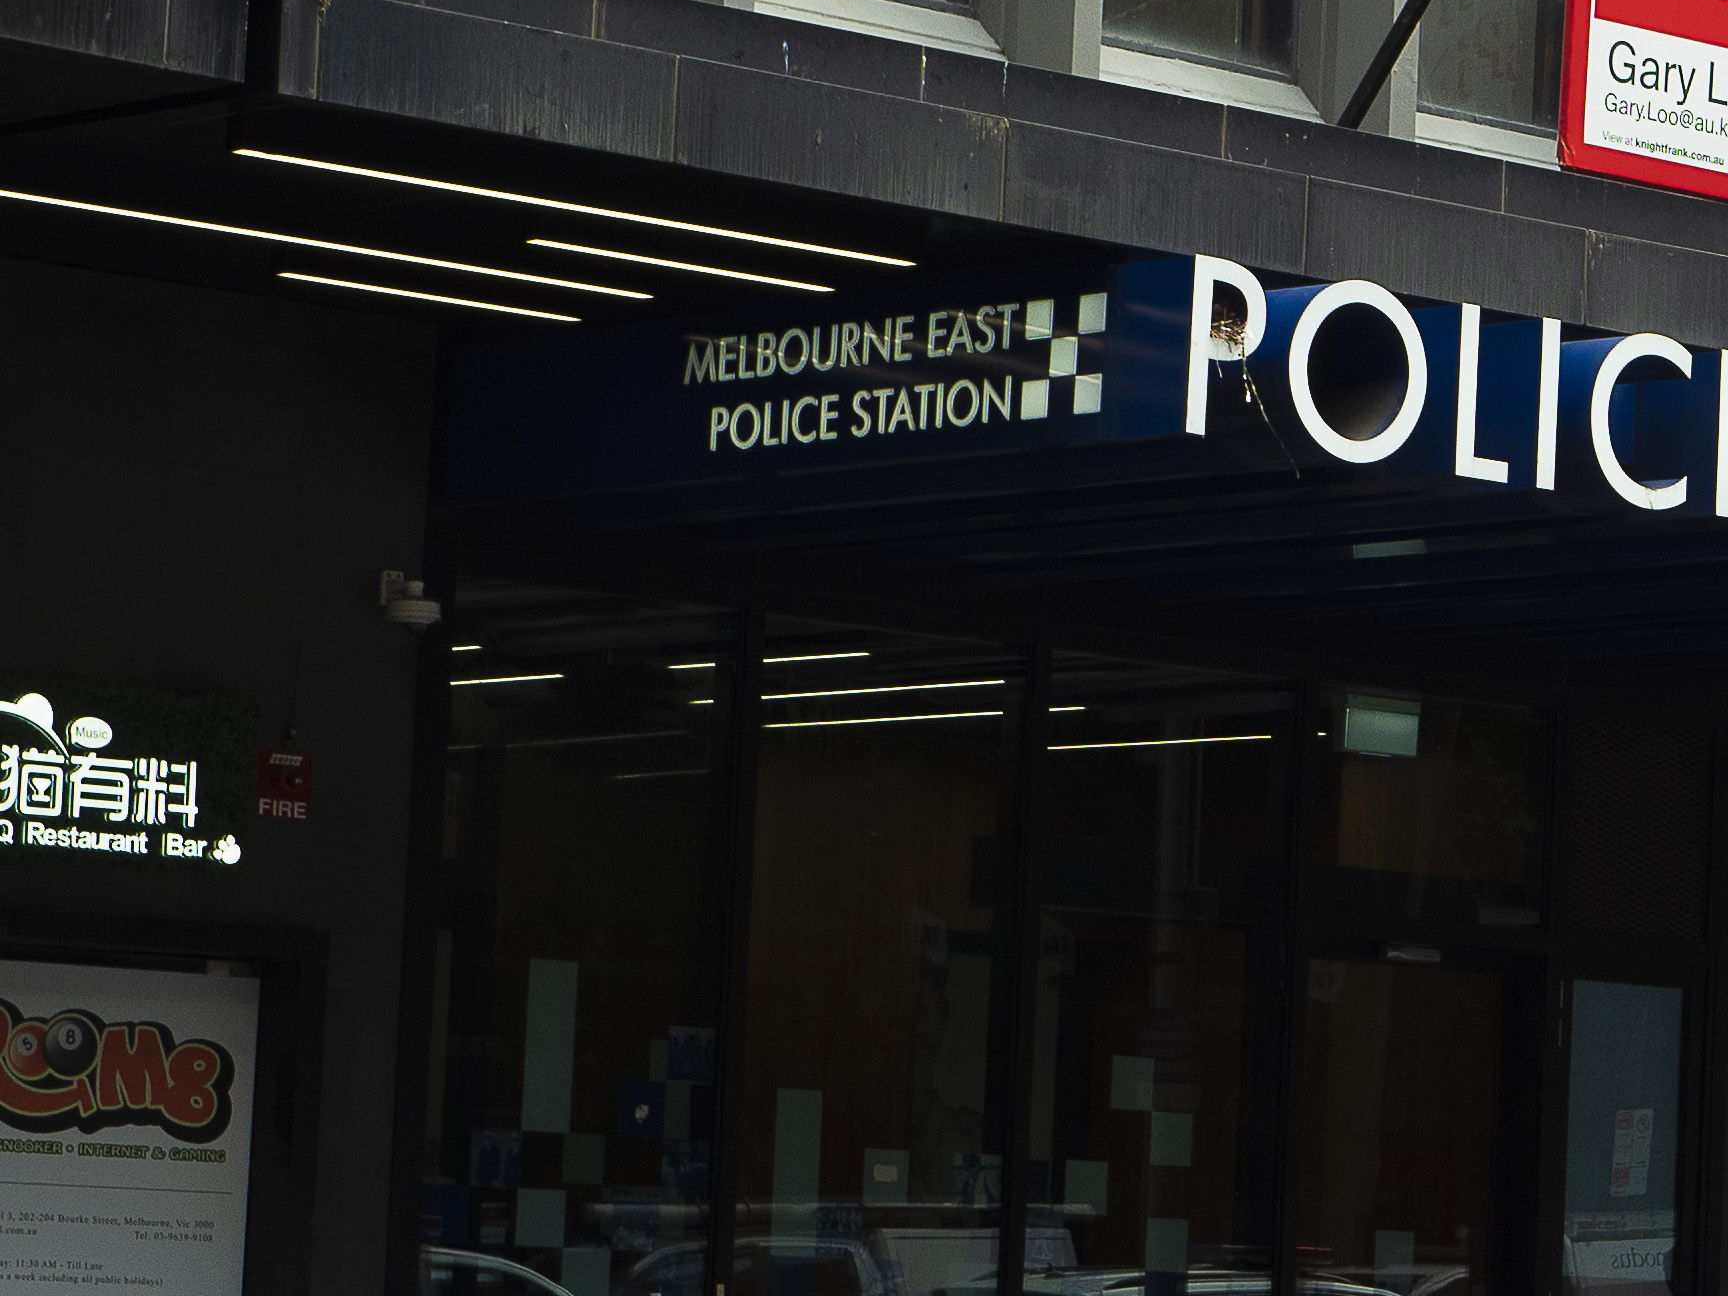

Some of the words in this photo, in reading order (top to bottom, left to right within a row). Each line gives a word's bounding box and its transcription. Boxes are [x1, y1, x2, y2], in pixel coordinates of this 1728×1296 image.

[1607, 39, 1697, 106] Gary
[1601, 129, 1623, 145] View
[1624, 136, 1634, 146] at
[1634, 137, 1725, 166] knightfrank.com.au
[683, 316, 915, 385] MELBOURNE
[927, 304, 1020, 359] EAST
[709, 394, 840, 452] POLICE
[851, 375, 1012, 438] STATION
[75, 726, 109, 740] Music
[259, 798, 307, 820] FIRE
[25, 821, 149, 854] Restaurant
[165, 833, 208, 858] Bar
[65, 1029, 76, 1047] 8
[78, 1142, 149, 1160] INTERNET
[151, 1146, 165, 1160] &
[169, 1148, 228, 1164] GAMING
[18, 1212, 55, 1223] 202-204
[57, 1214, 89, 1225] Bourke
[123, 1217, 173, 1230] Melbourne,
[39, 1274, 79, 1286] including
[95, 1276, 121, 1287] public
